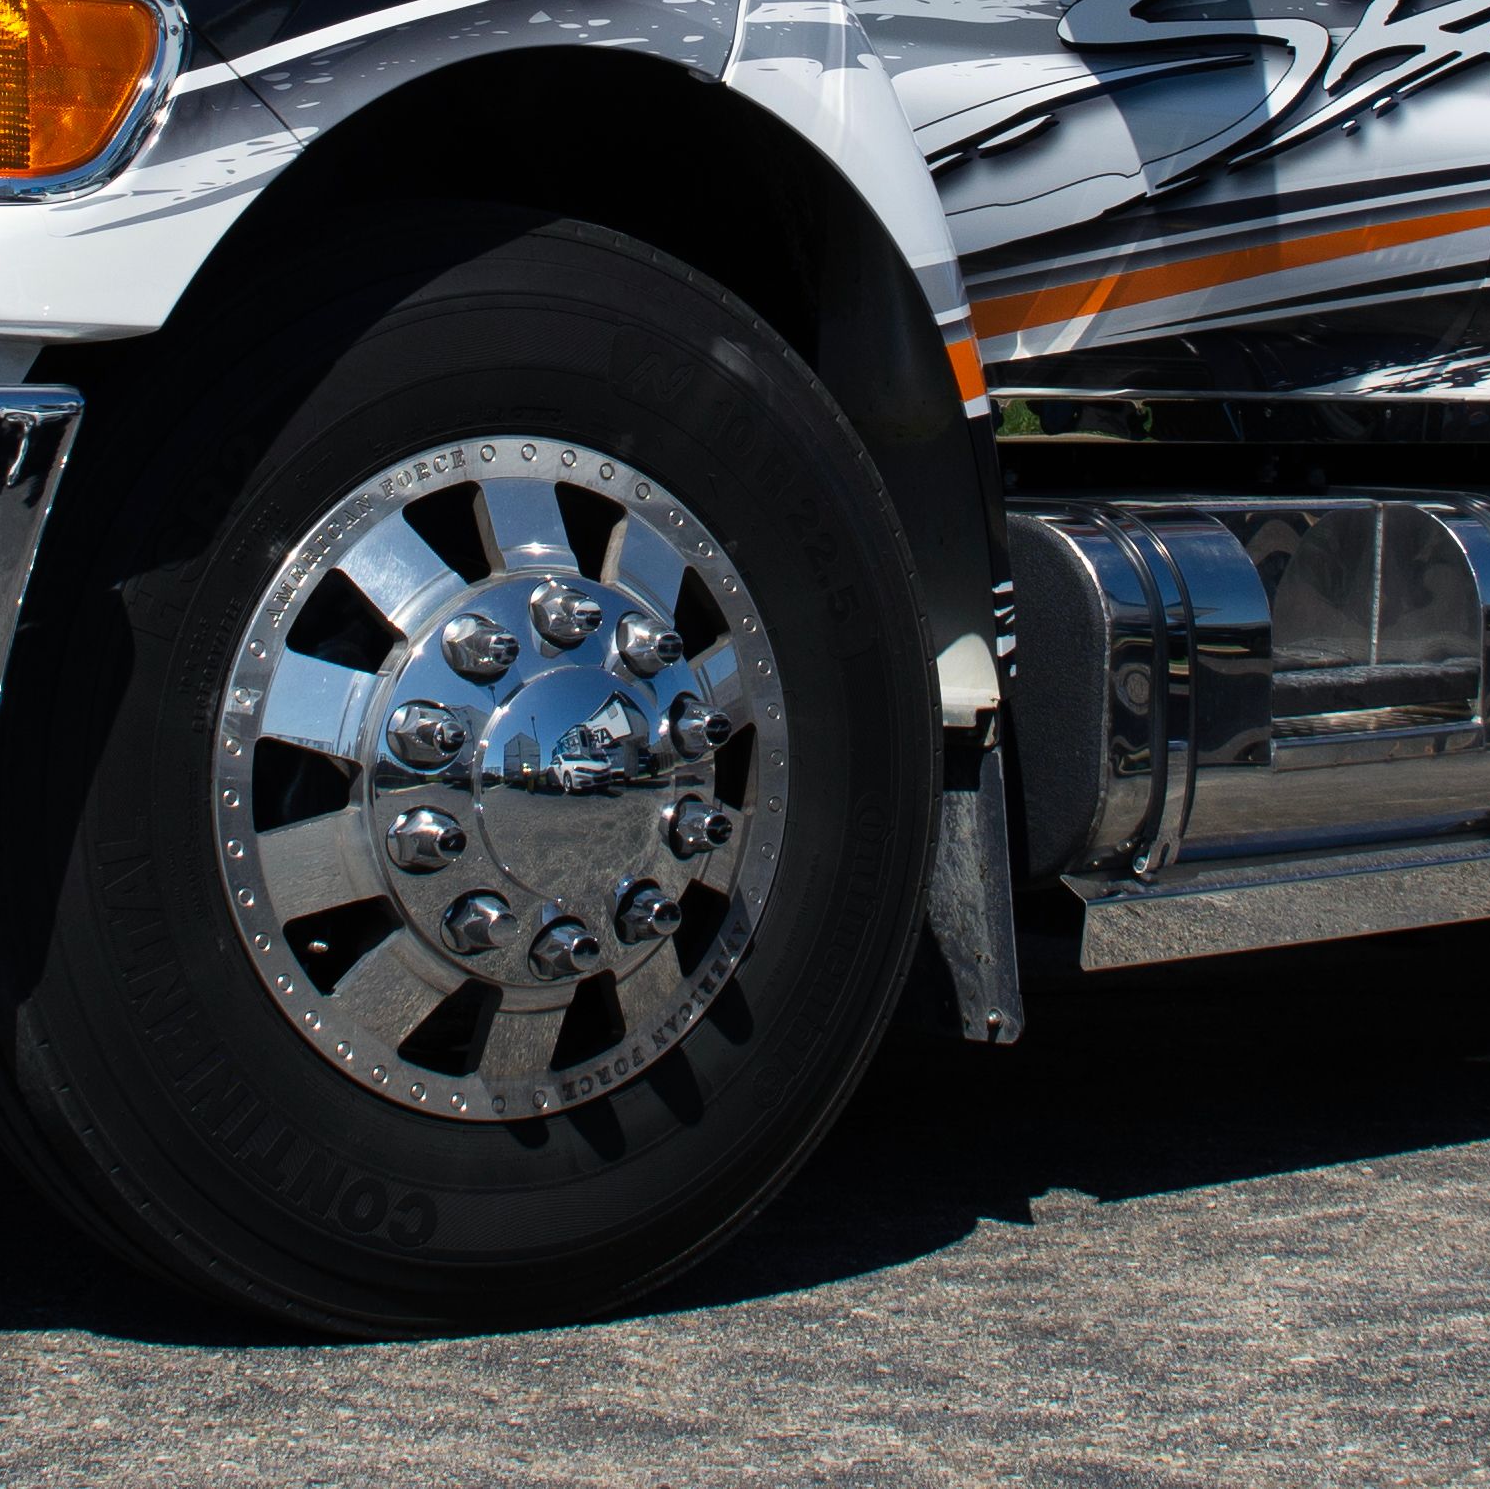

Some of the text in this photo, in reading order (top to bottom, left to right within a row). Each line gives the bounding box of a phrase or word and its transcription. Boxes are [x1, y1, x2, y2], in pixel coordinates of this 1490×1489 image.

[268, 493, 375, 628] AMERICAN
[378, 448, 467, 501] FORCE
[651, 920, 748, 1051] AMERICAN
[561, 1045, 645, 1101] FORCE
